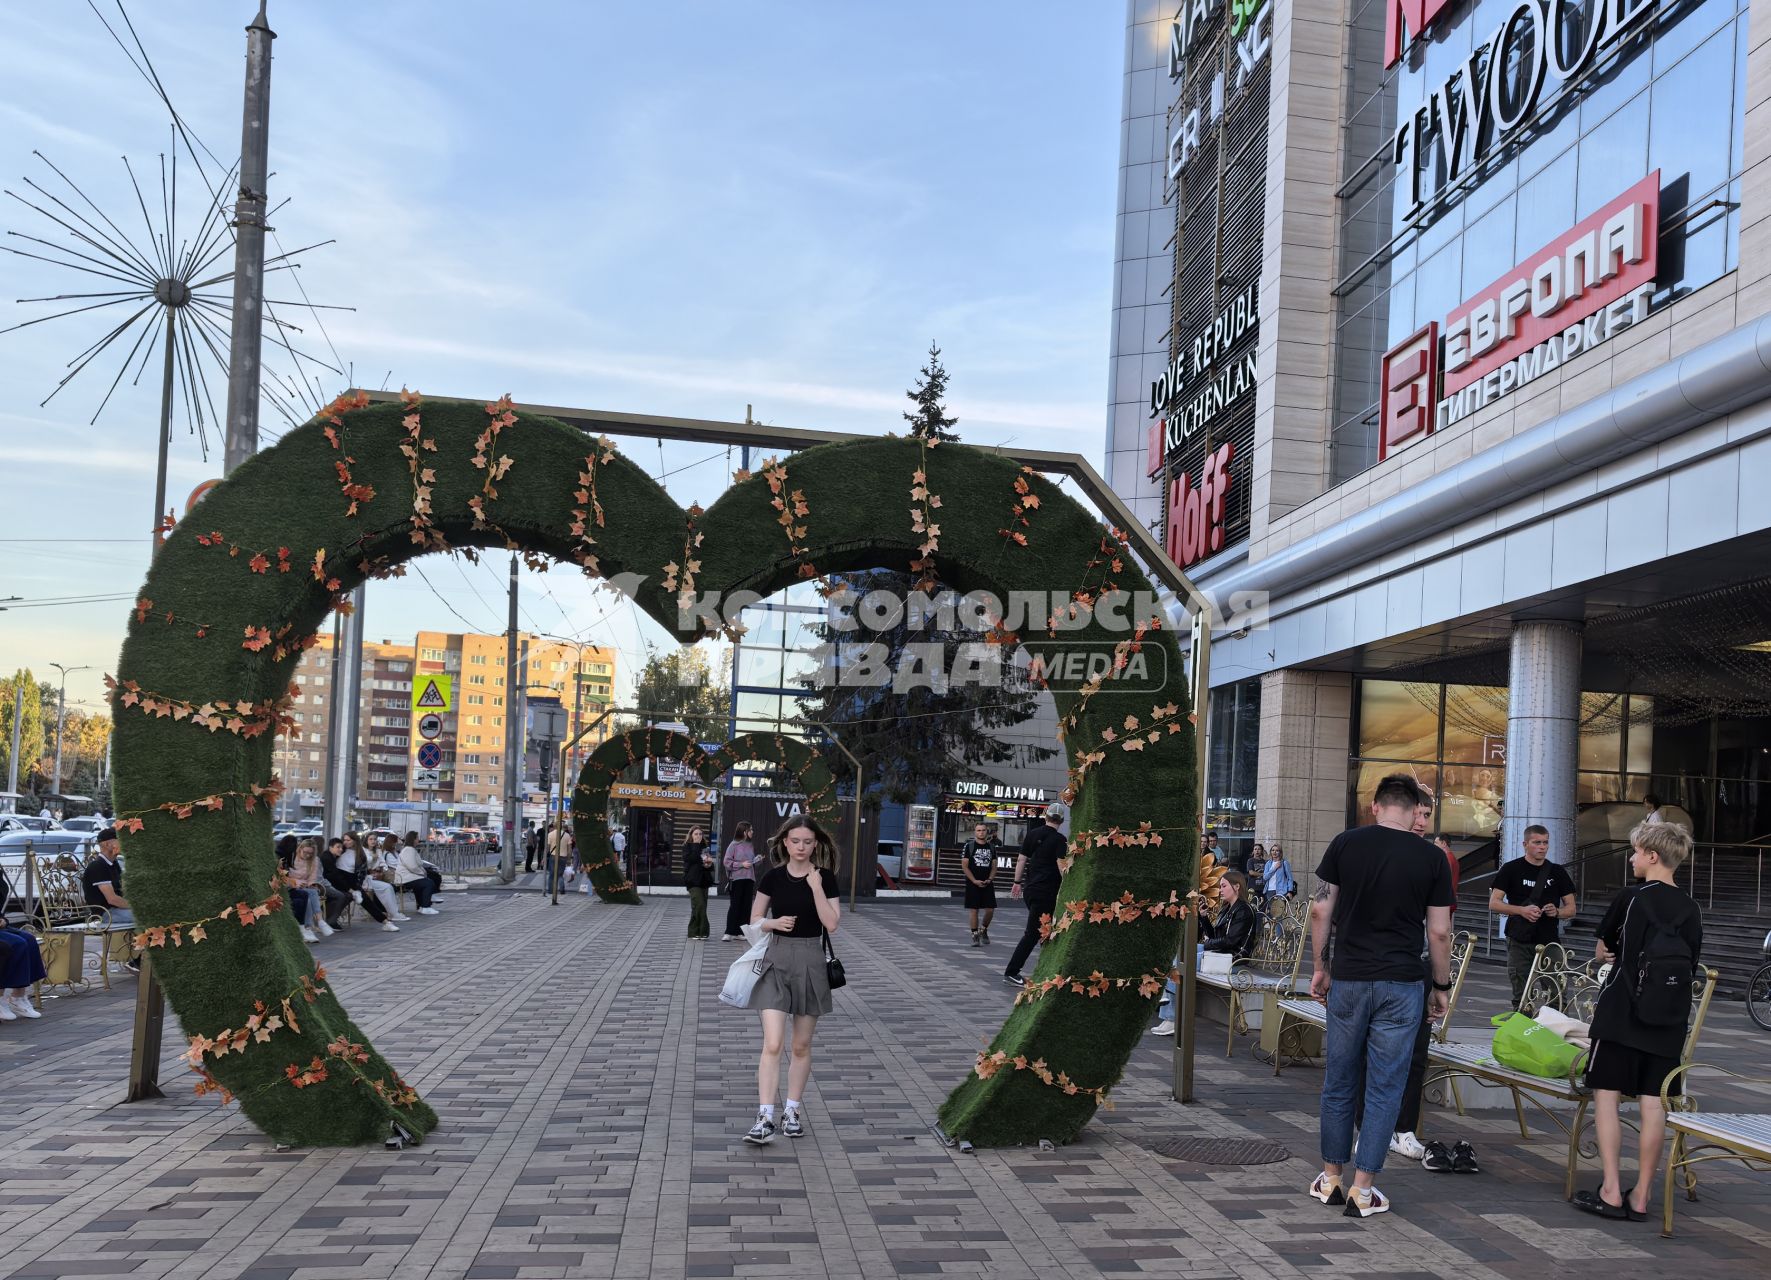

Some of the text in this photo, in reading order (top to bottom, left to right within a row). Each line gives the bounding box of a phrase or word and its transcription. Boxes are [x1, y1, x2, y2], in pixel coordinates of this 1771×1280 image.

[1445, 203, 1644, 374] ЕВРОПА
[1436, 282, 1657, 431] ГИПЕРМАРКЕТ
[1149, 351, 1185, 418] LOVE
[618, 787, 686, 799] КОФЕ С СОБОЙ
[695, 789, 718, 805] 24
[956, 781, 1045, 801] СУПЕР ШАУРМА
